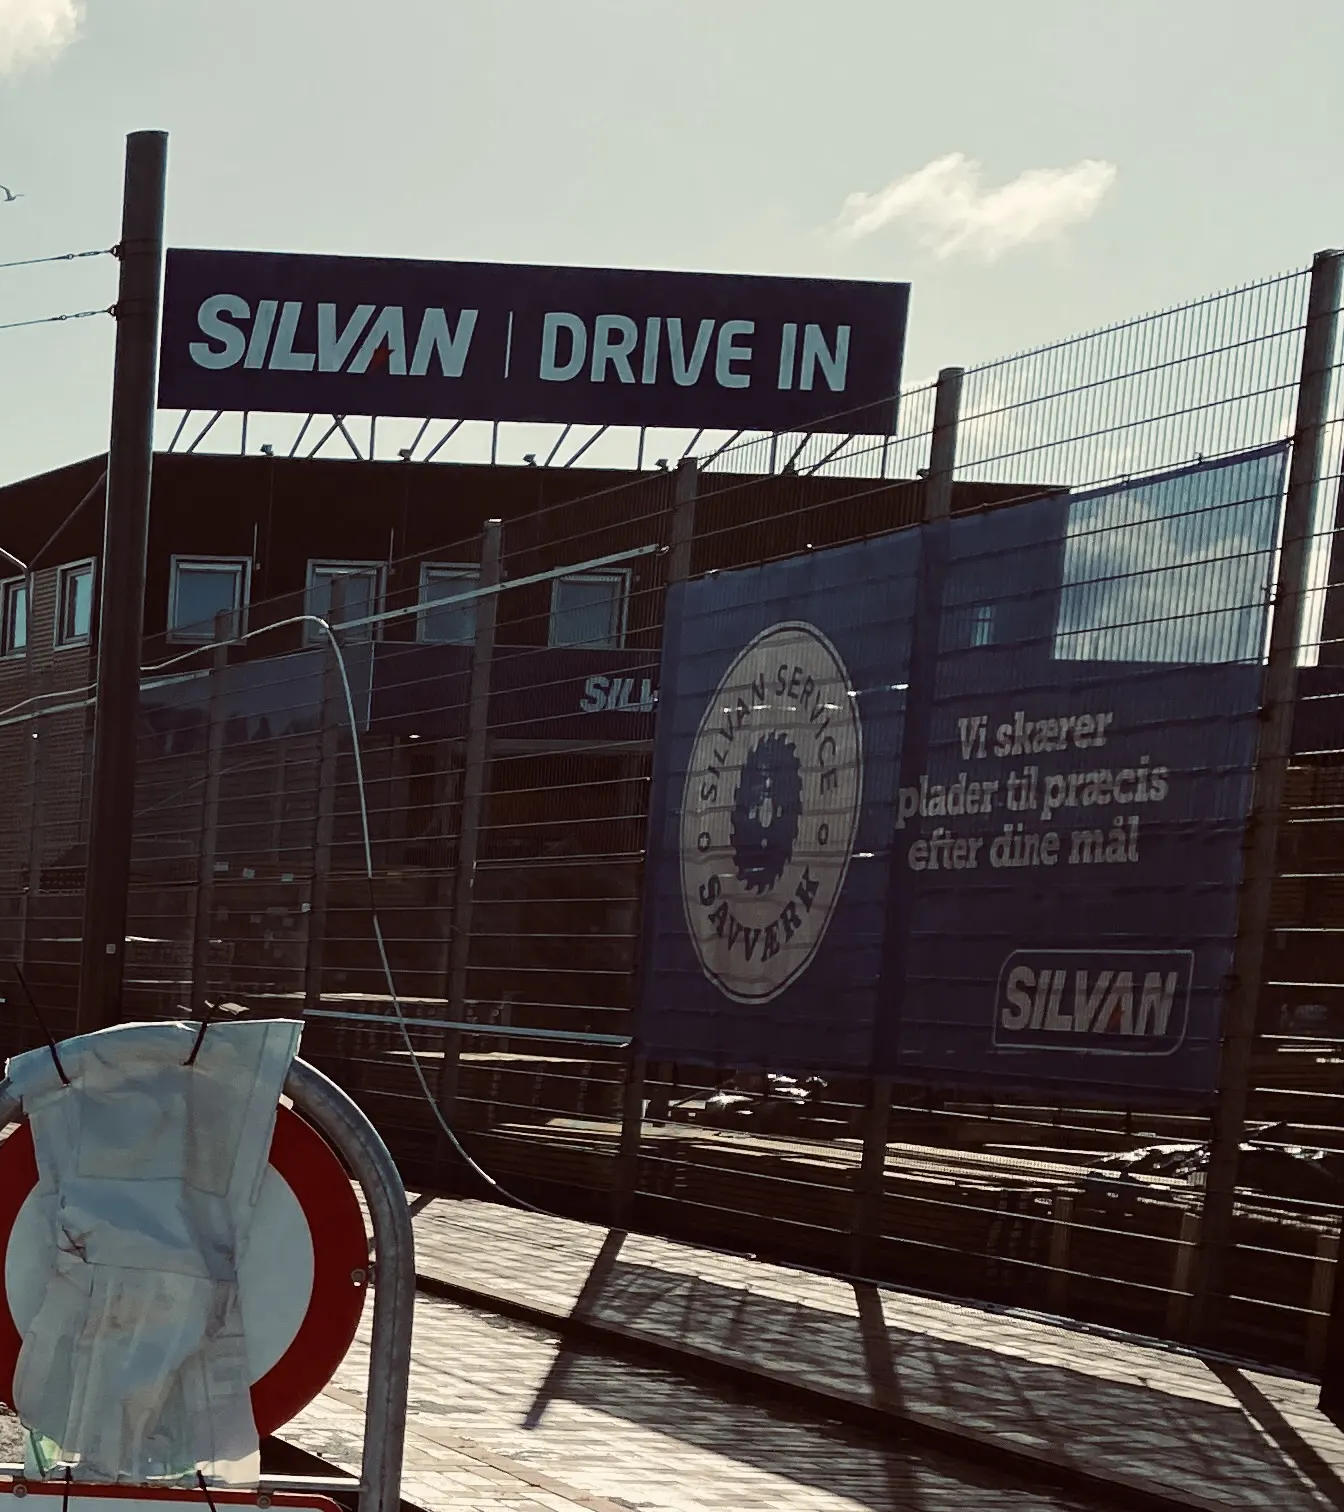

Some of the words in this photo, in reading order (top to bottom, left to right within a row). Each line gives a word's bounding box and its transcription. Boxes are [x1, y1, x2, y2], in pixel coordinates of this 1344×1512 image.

[189, 293, 478, 379] SILVAN
[539, 311, 755, 390] DRIVE
[777, 322, 851, 392] IN
[700, 672, 768, 804] SILVAN
[774, 663, 842, 796] SERVICE
[958, 715, 989, 760] Vi
[993, 710, 1114, 757] skærer
[895, 772, 999, 829] plader
[1006, 765, 1039, 811] til
[1040, 755, 1169, 820] præcis
[908, 827, 983, 871] efter
[989, 822, 1060, 868] dine
[1068, 815, 1140, 865] mål
[698, 866, 821, 964] SAVVÆRK
[1000, 965, 1179, 1036] SILVAN
